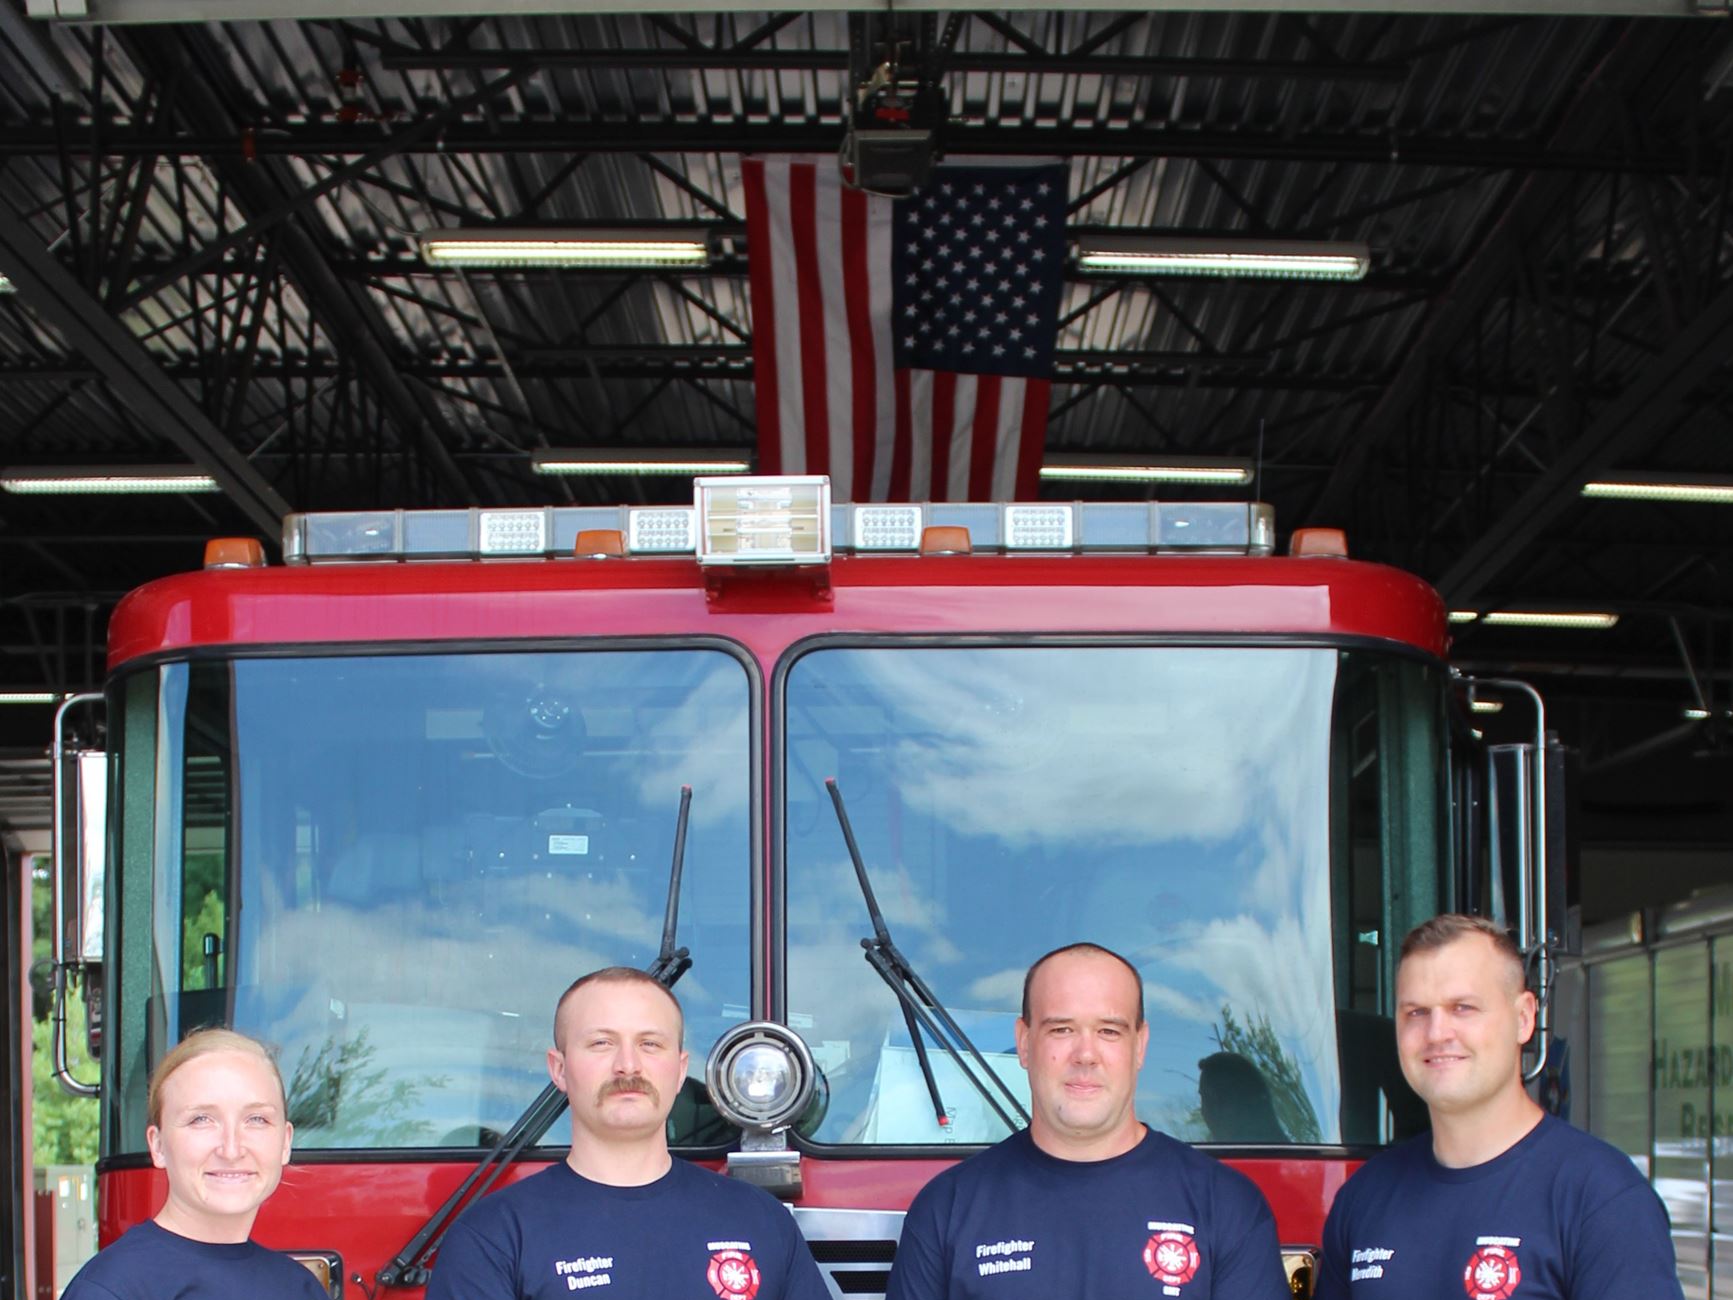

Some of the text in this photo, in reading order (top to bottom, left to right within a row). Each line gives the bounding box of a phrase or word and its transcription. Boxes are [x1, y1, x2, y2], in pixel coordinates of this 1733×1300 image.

[976, 1240, 1035, 1258] Firefighter
[555, 1256, 613, 1275] Firefighter
[978, 1257, 1031, 1276] Whitehall
[567, 1273, 611, 1290] Duncan
